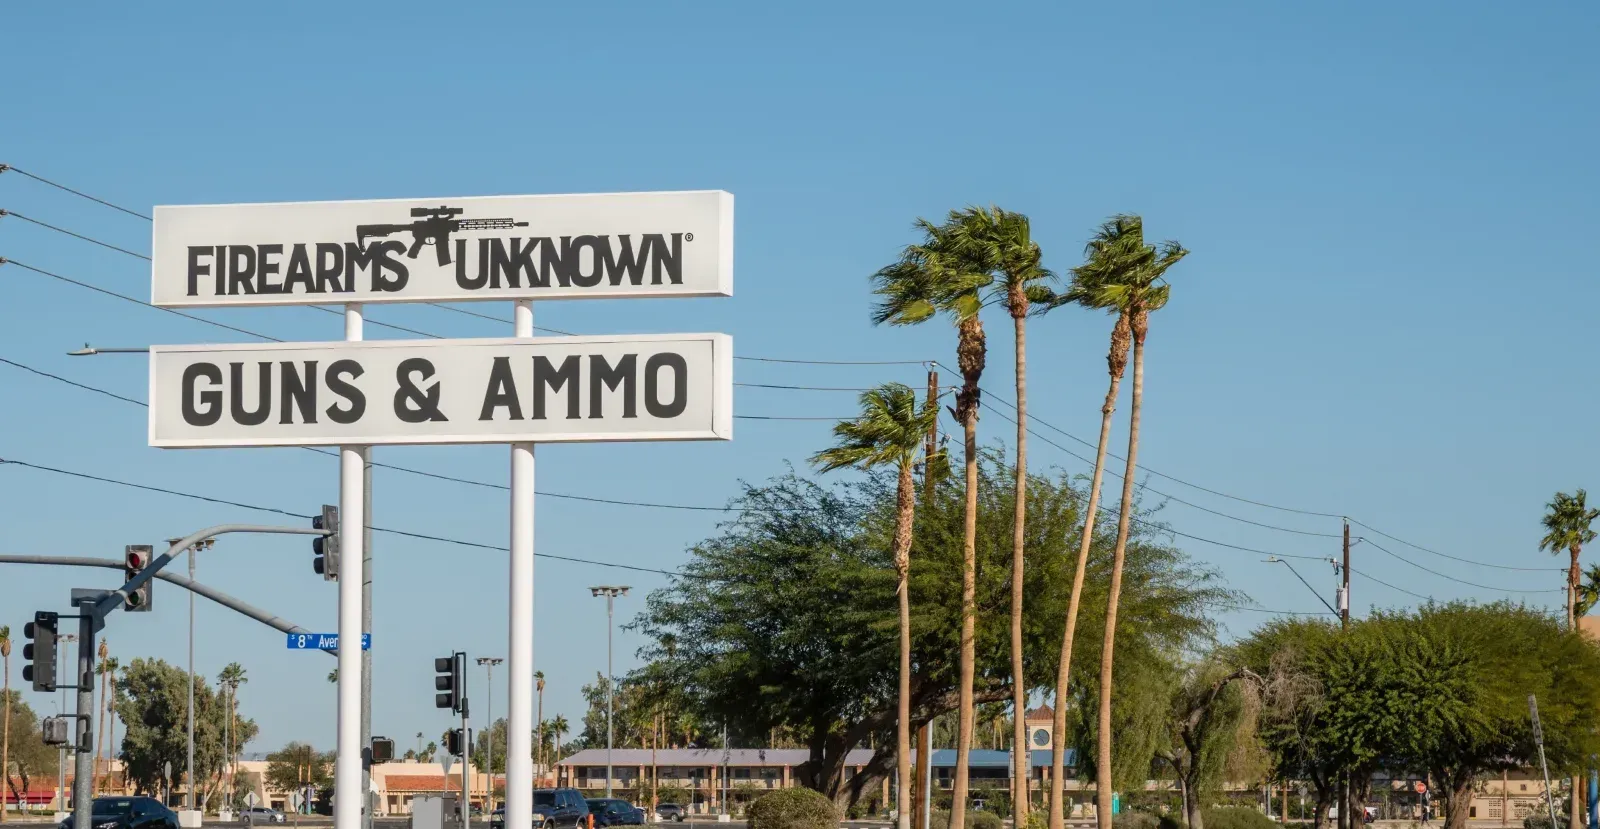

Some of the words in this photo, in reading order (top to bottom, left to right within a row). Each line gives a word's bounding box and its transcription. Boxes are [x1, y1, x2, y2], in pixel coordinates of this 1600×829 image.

[187, 242, 409, 295] FIREARMS
[181, 359, 366, 426] GUNS
[393, 357, 449, 422] &
[478, 352, 688, 421] AMMO
